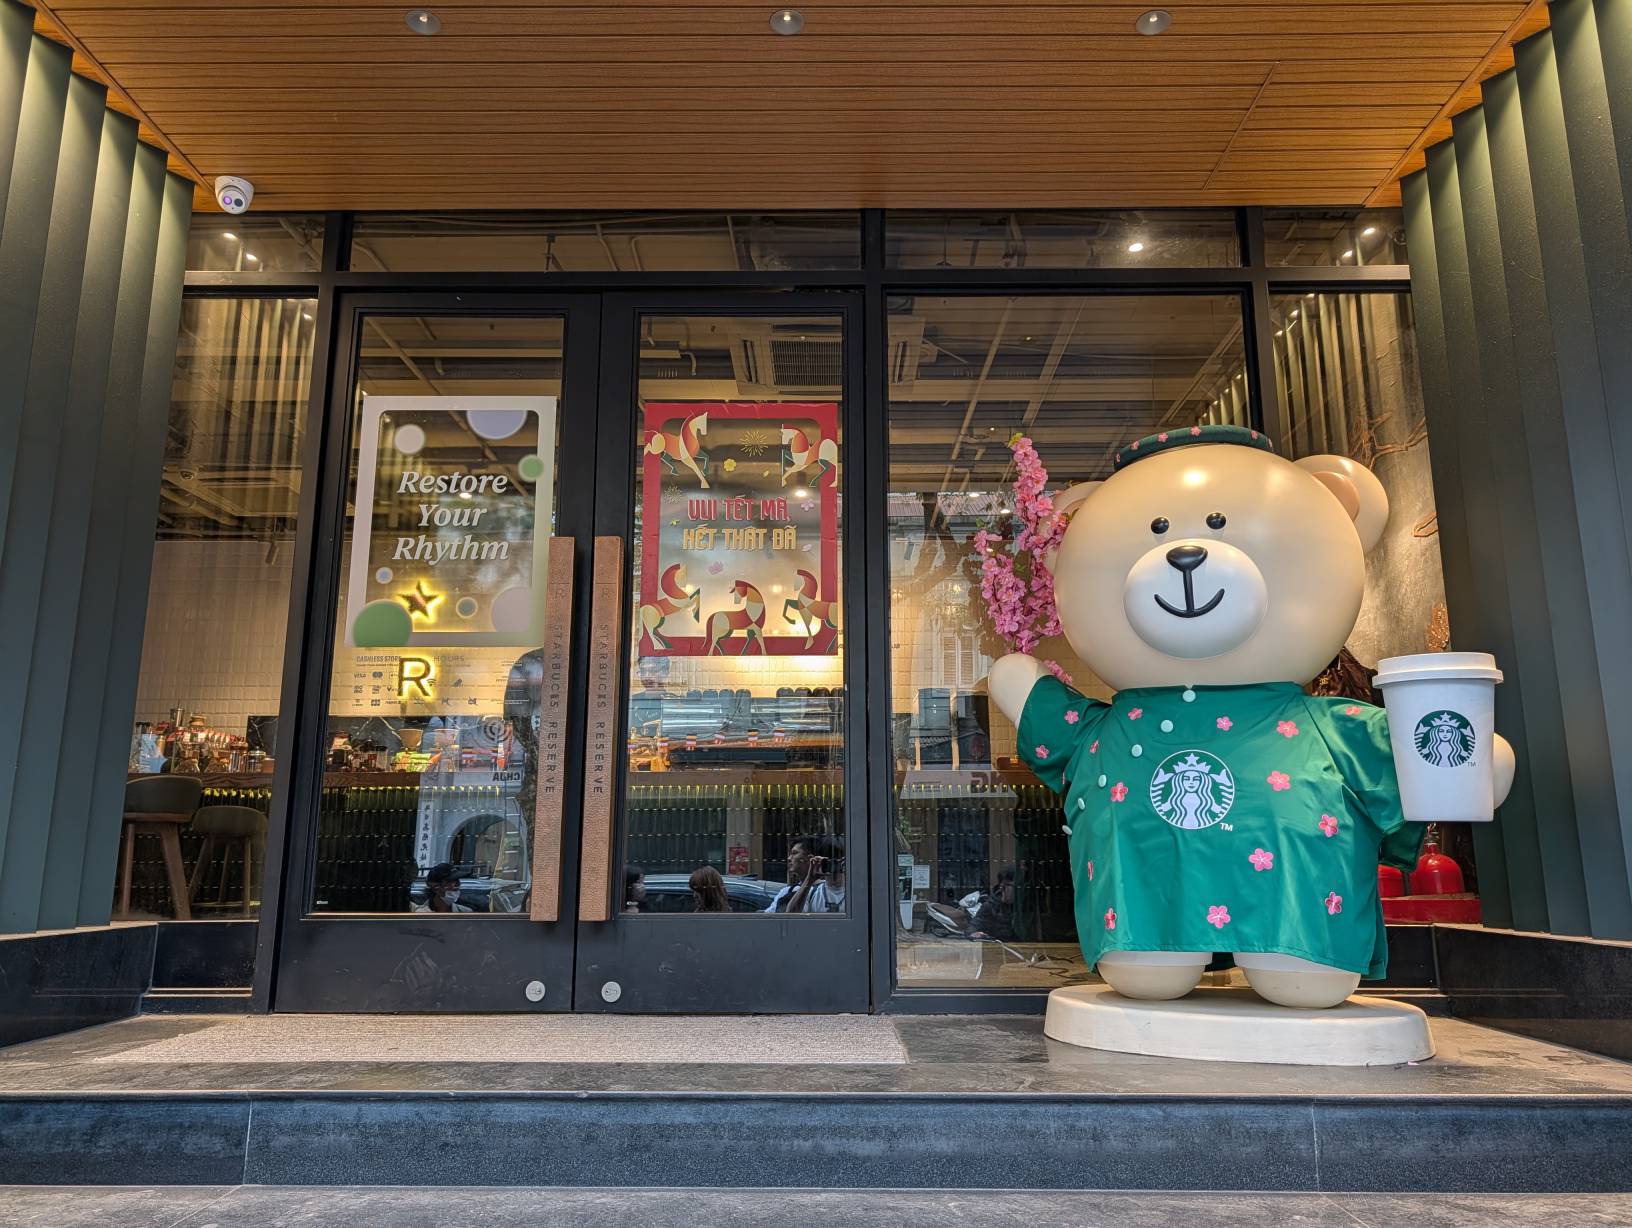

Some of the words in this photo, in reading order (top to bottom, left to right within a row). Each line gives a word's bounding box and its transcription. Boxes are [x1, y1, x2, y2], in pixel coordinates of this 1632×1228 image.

[396, 470, 509, 494] Restore
[417, 502, 488, 527] Your
[687, 498, 717, 521] VUI
[722, 494, 755, 521] TẾT
[391, 534, 510, 566] Rhythm
[682, 523, 718, 551] HẾT
[721, 525, 768, 552] THẬT
[771, 525, 798, 551] ĐÃ
[397, 657, 432, 697] R
[549, 625, 563, 708] STARBUCKS
[597, 624, 609, 708] STARBUCKS
[545, 721, 558, 793] RESERVE
[593, 721, 605, 793] RESERVE
[1220, 822, 1234, 832] TM
